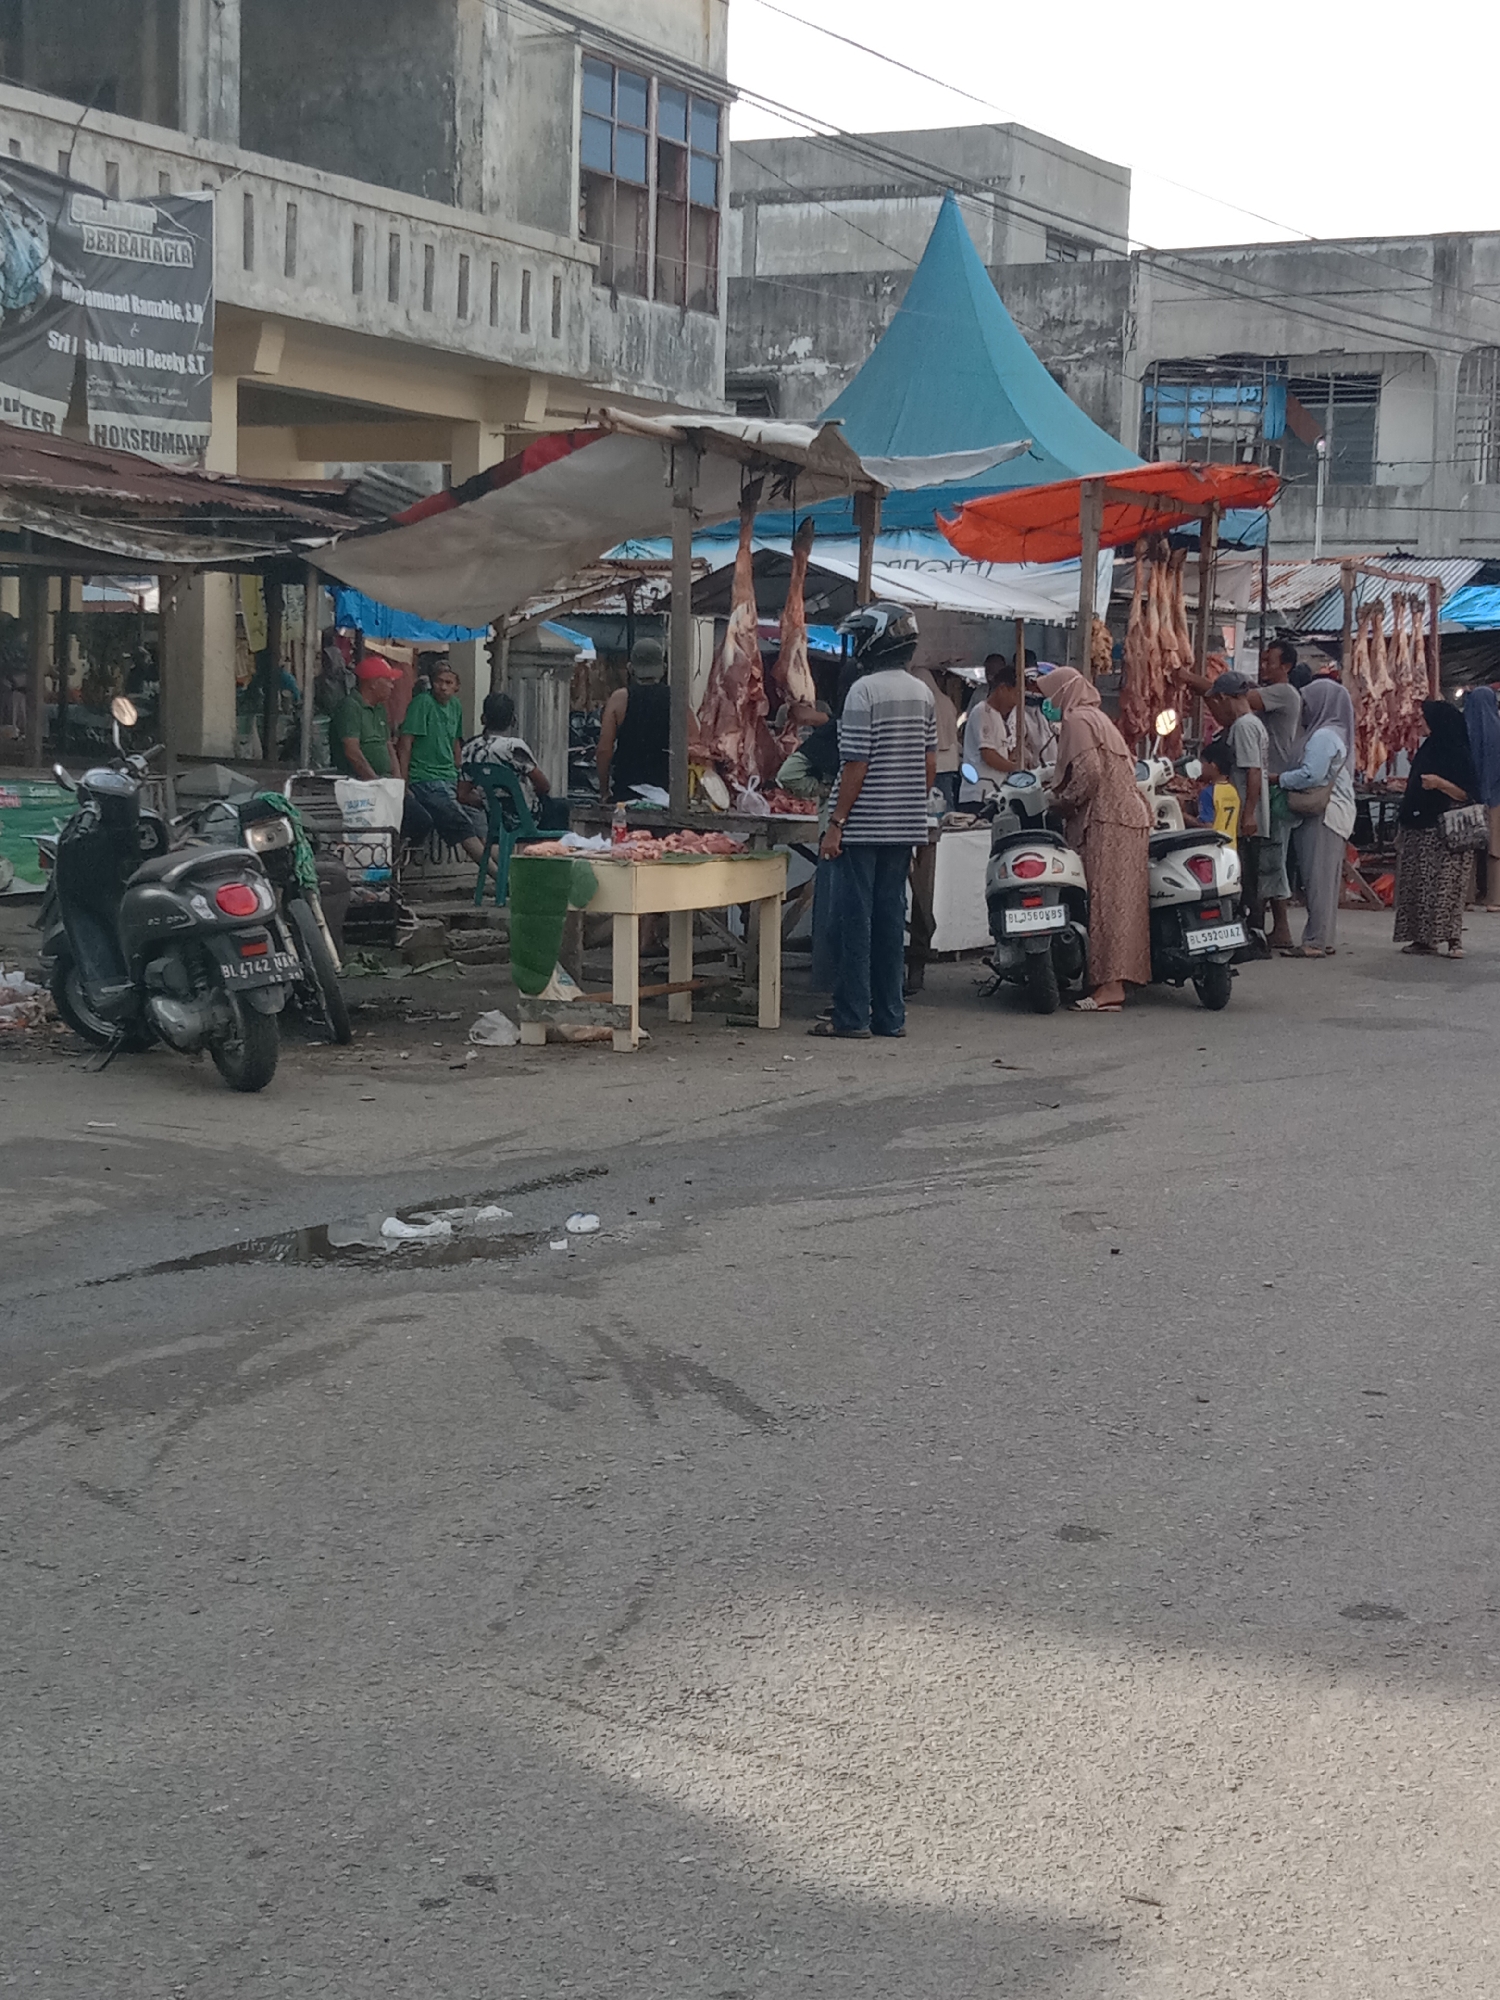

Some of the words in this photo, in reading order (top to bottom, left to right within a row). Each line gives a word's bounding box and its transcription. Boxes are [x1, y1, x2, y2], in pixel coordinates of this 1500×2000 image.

[84, 226, 193, 267] BERBAHAGIA
[48, 329, 71, 354] Sri
[0, 396, 56, 433] UTER
[1223, 806, 1236, 831] 7
[220, 963, 240, 979] BL
